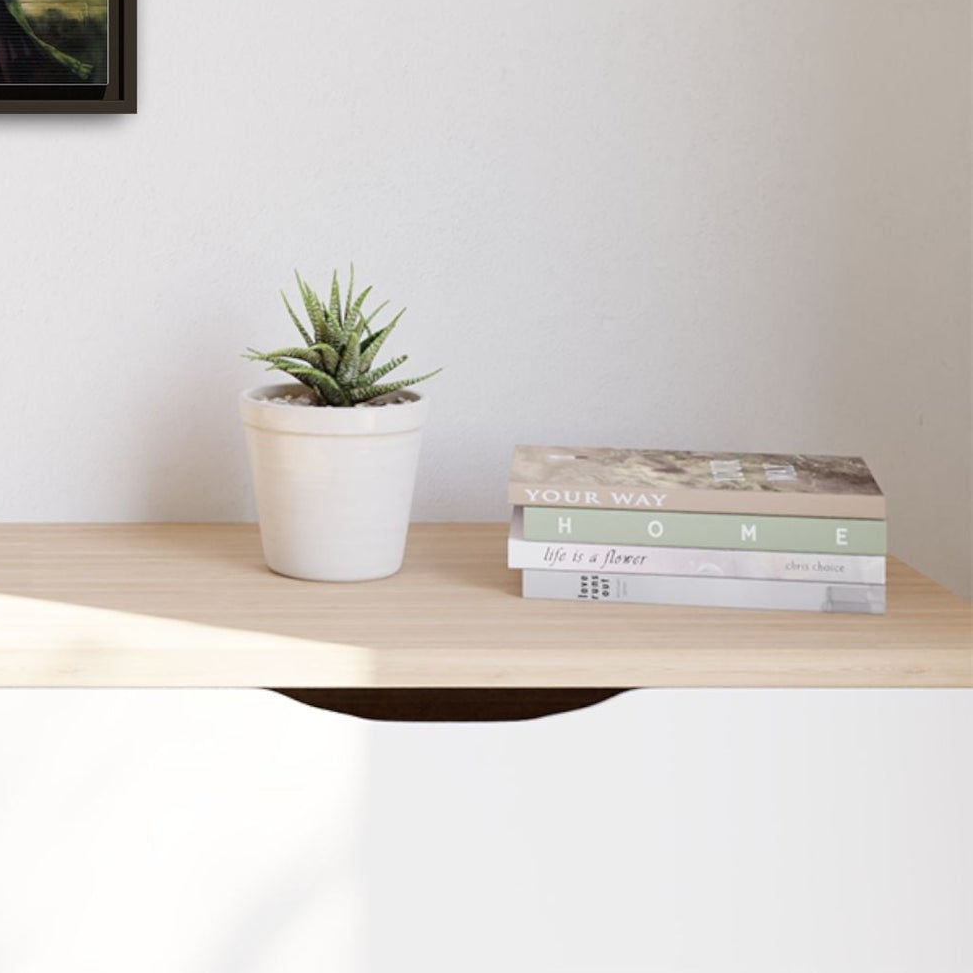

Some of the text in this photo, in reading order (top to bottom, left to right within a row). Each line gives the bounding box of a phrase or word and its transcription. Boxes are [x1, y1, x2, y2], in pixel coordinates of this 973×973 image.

[525, 489, 667, 506] YOUR WAY
[558, 517, 848, 545] HOME
[544, 547, 647, 569] life is a flower
[785, 560, 846, 573] chris choice
[577, 575, 588, 598] love
[591, 575, 599, 600] runs
[600, 578, 610, 597] out
